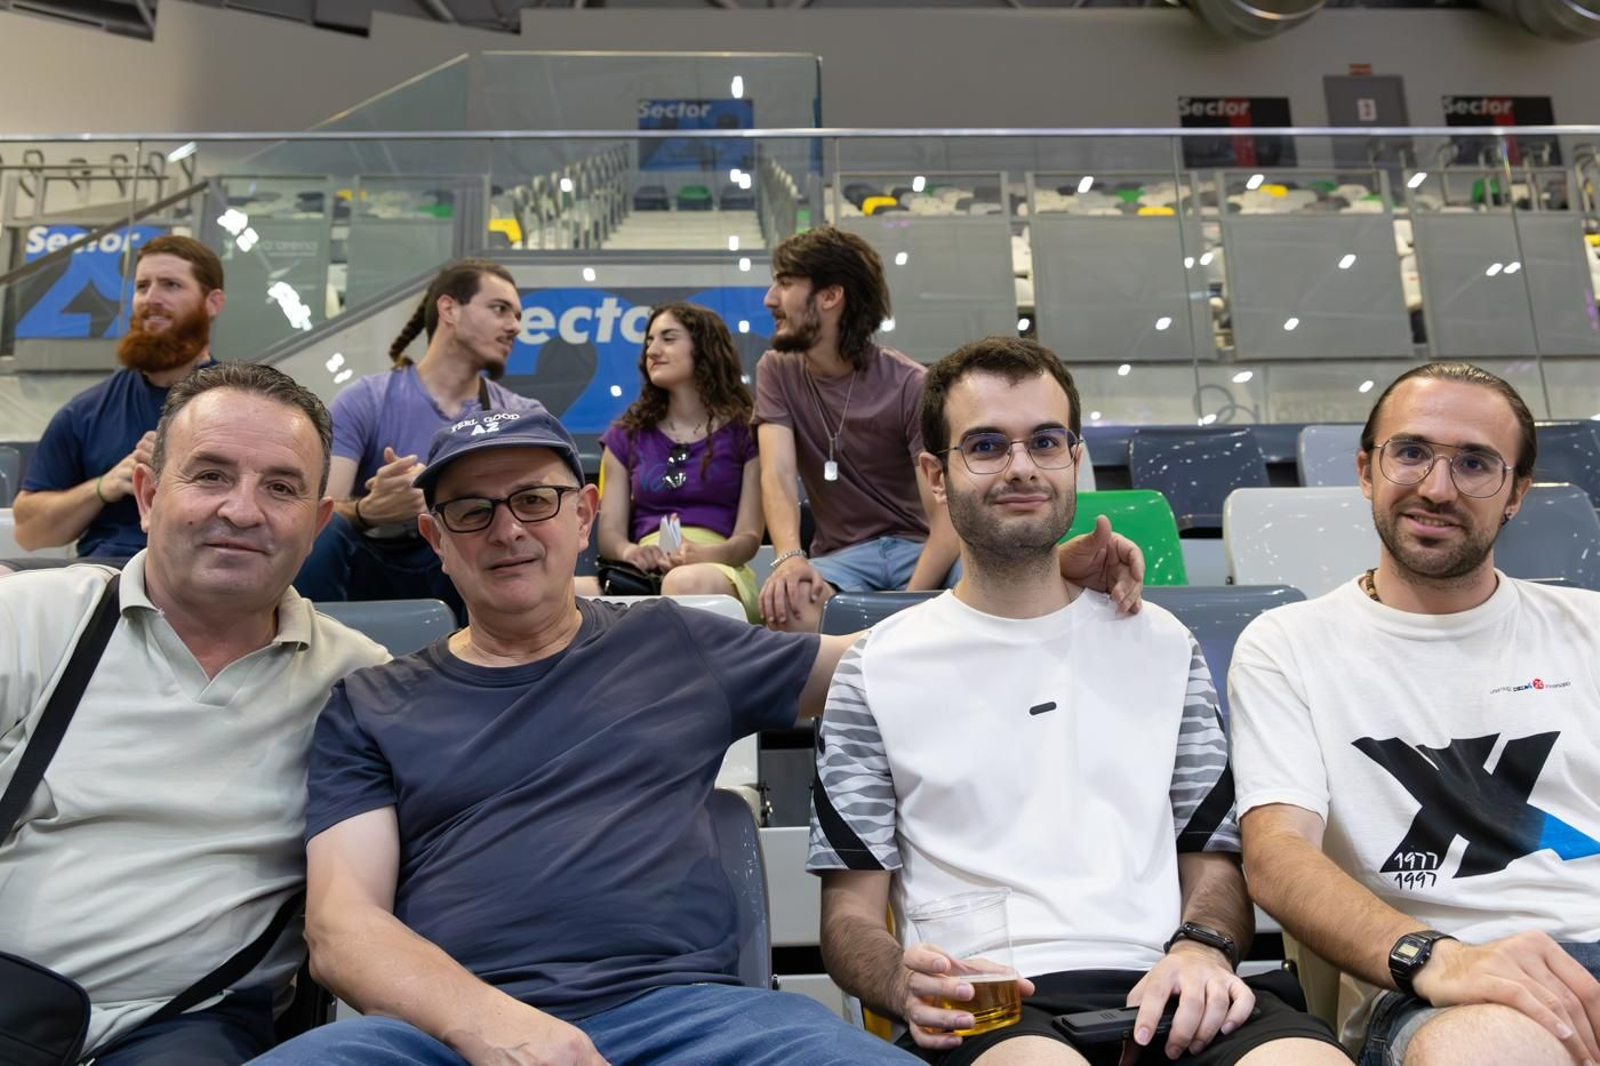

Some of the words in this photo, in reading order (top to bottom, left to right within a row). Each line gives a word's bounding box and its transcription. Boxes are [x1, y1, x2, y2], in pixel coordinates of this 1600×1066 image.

[638, 101, 712, 119] Sector
[1179, 97, 1251, 116] Sector
[1442, 96, 1513, 115] Sector
[515, 297, 652, 345] ecto
[451, 418, 479, 433] FEEL
[483, 413, 520, 423] GOOD
[1393, 851, 1439, 869] 1977
[1394, 871, 1437, 890] 1997
